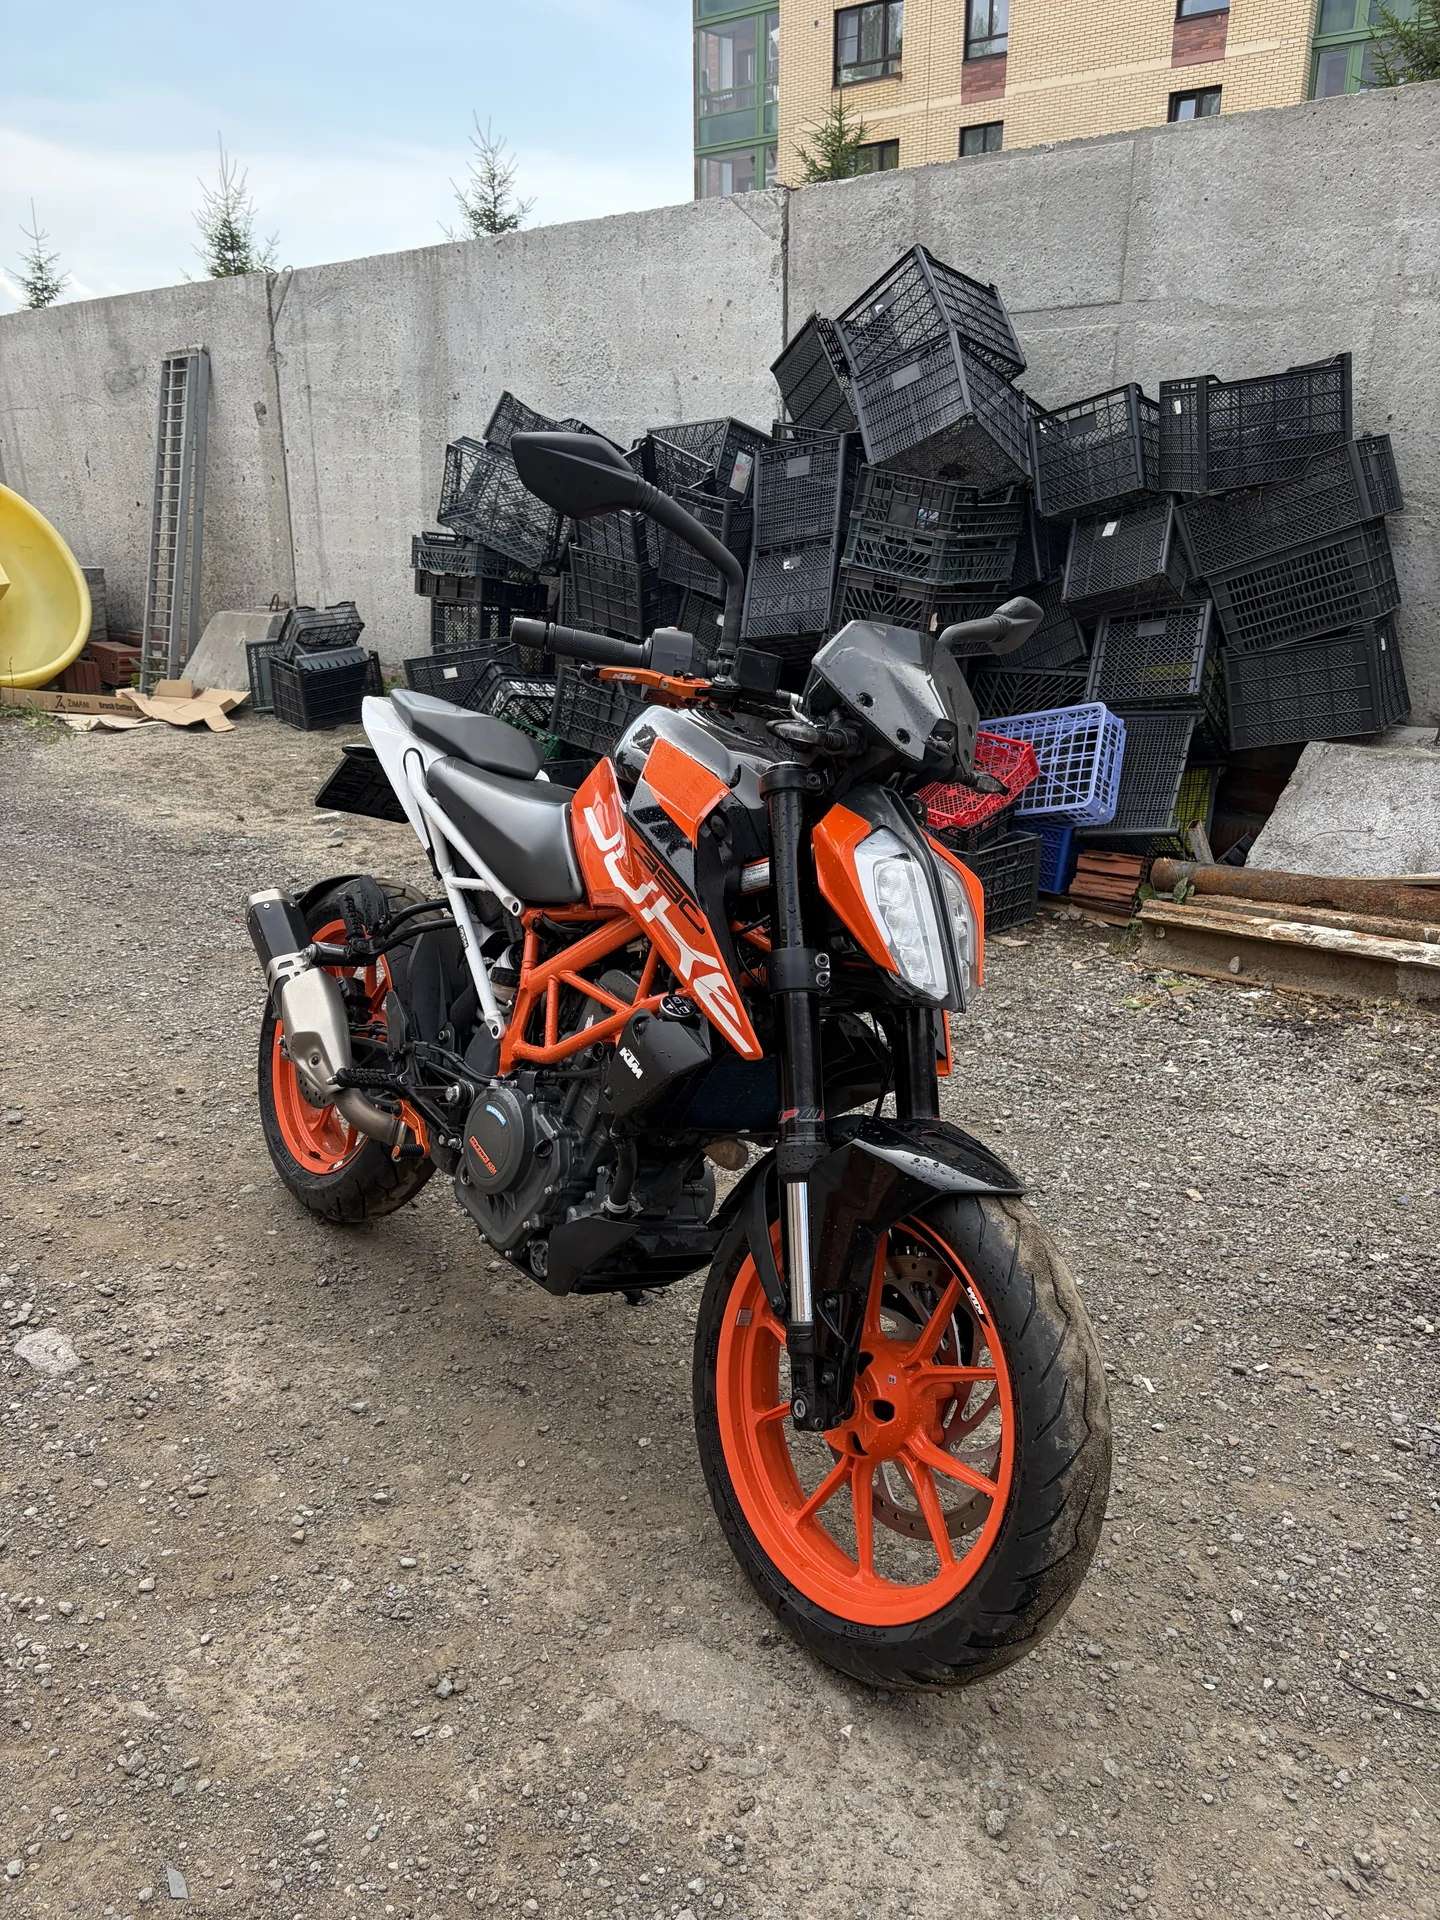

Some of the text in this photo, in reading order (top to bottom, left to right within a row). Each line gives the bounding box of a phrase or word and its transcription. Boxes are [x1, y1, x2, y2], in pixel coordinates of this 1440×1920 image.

[612, 673, 636, 681] KTM
[98, 701, 115, 710] Brush
[632, 845, 706, 936] 390
[583, 806, 754, 1053] DUKE
[619, 1046, 644, 1080] KTM
